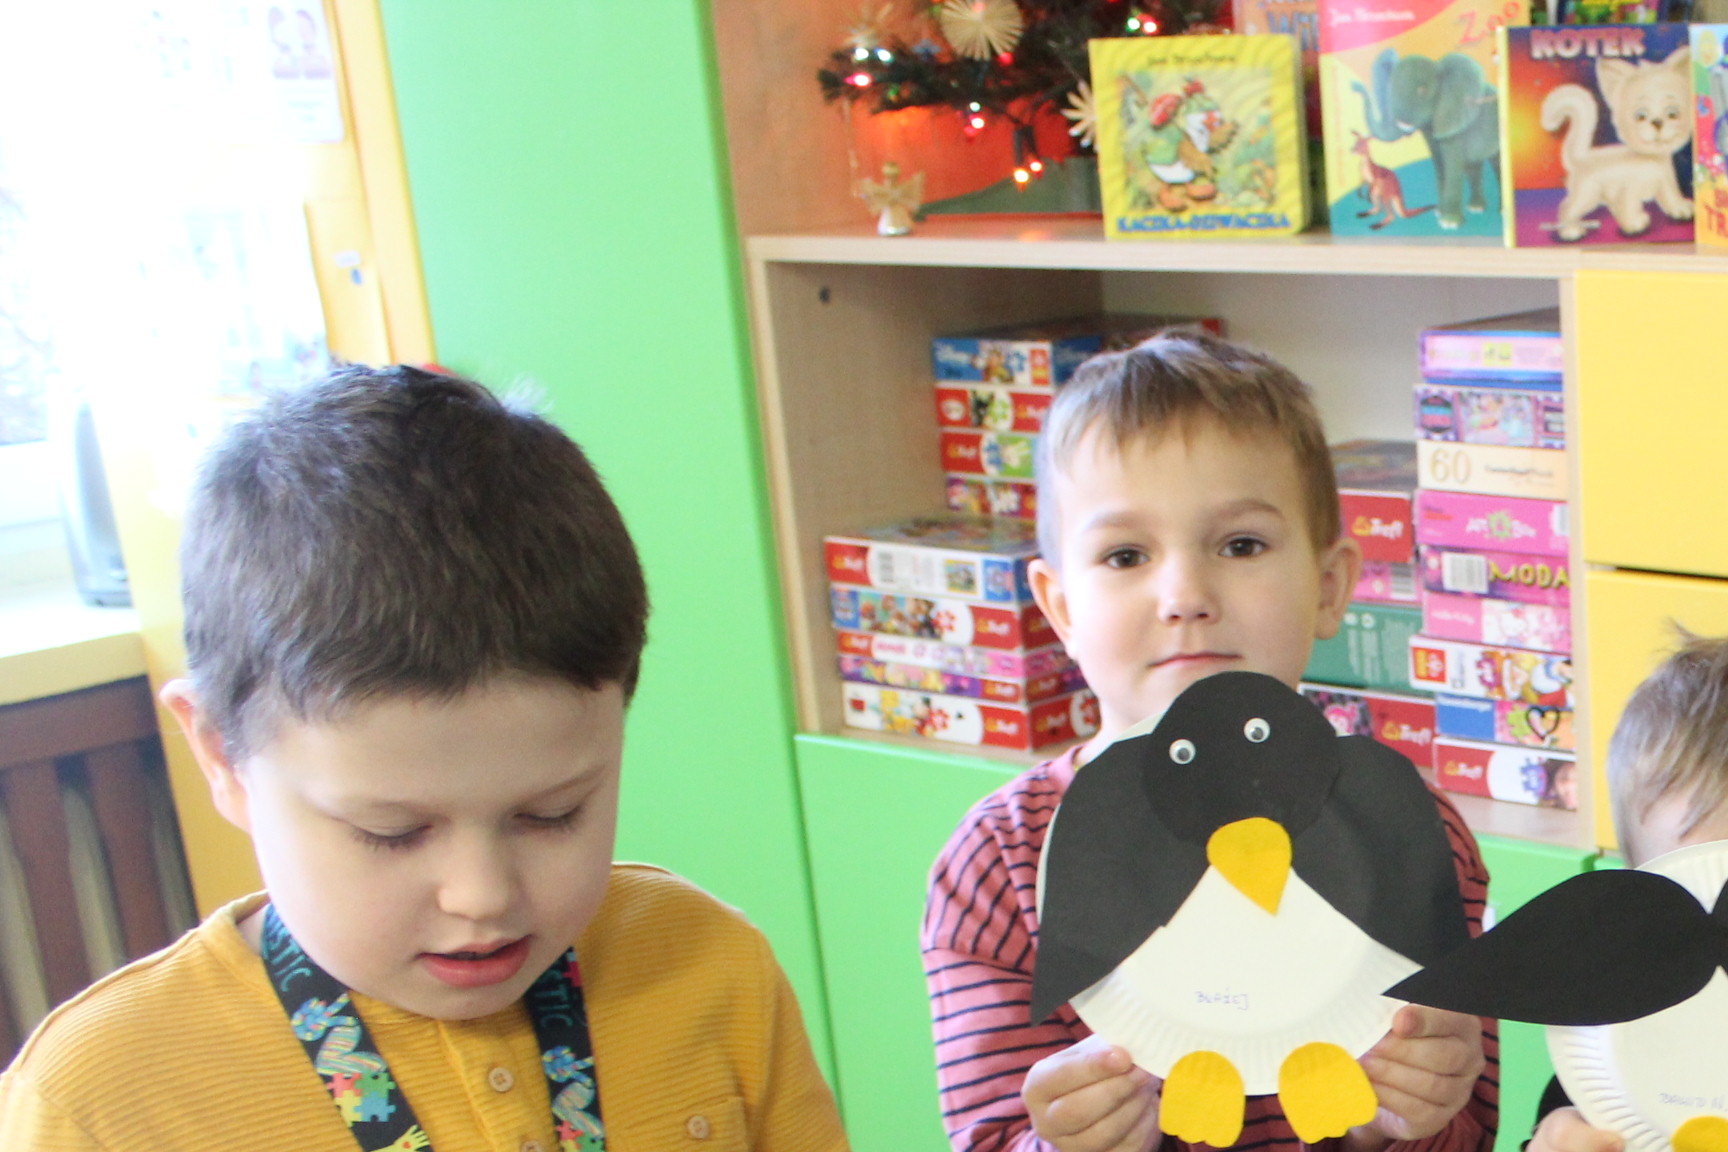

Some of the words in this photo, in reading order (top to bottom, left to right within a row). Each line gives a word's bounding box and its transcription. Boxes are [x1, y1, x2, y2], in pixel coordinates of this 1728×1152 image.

[1531, 27, 1646, 59] KOTEK
[1430, 448, 1472, 484] 60
[1489, 561, 1570, 590] MODA
